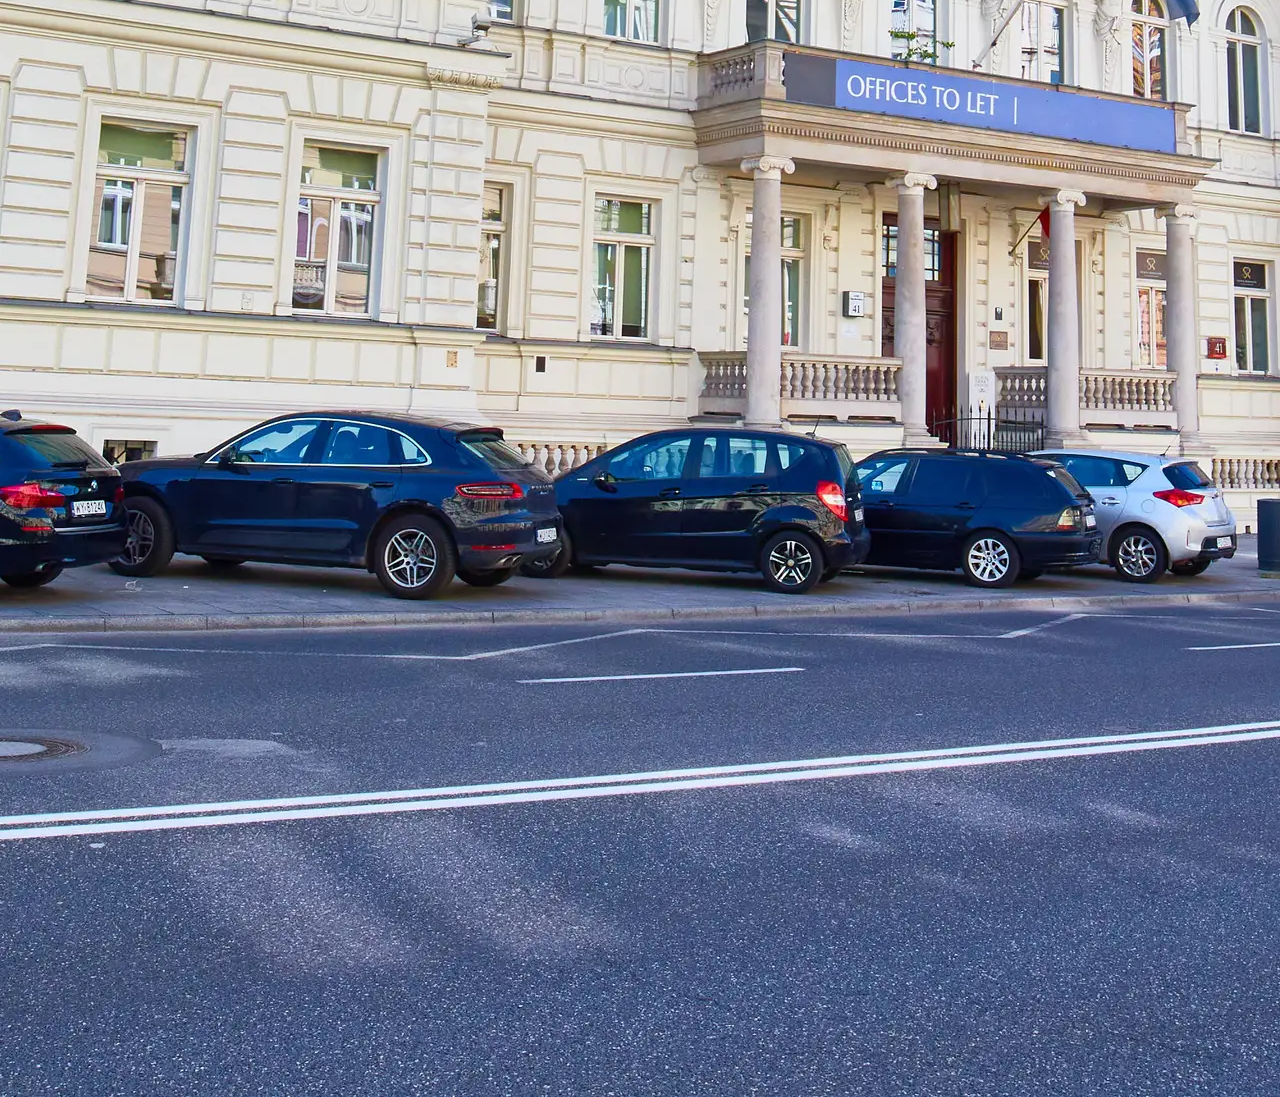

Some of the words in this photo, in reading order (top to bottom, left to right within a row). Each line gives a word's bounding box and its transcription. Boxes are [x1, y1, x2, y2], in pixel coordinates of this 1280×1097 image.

[846, 74, 927, 105] OFFICES
[931, 85, 960, 110] TO
[967, 91, 999, 116] LET
[852, 305, 860, 313] 41
[1214, 342, 1223, 354] 41
